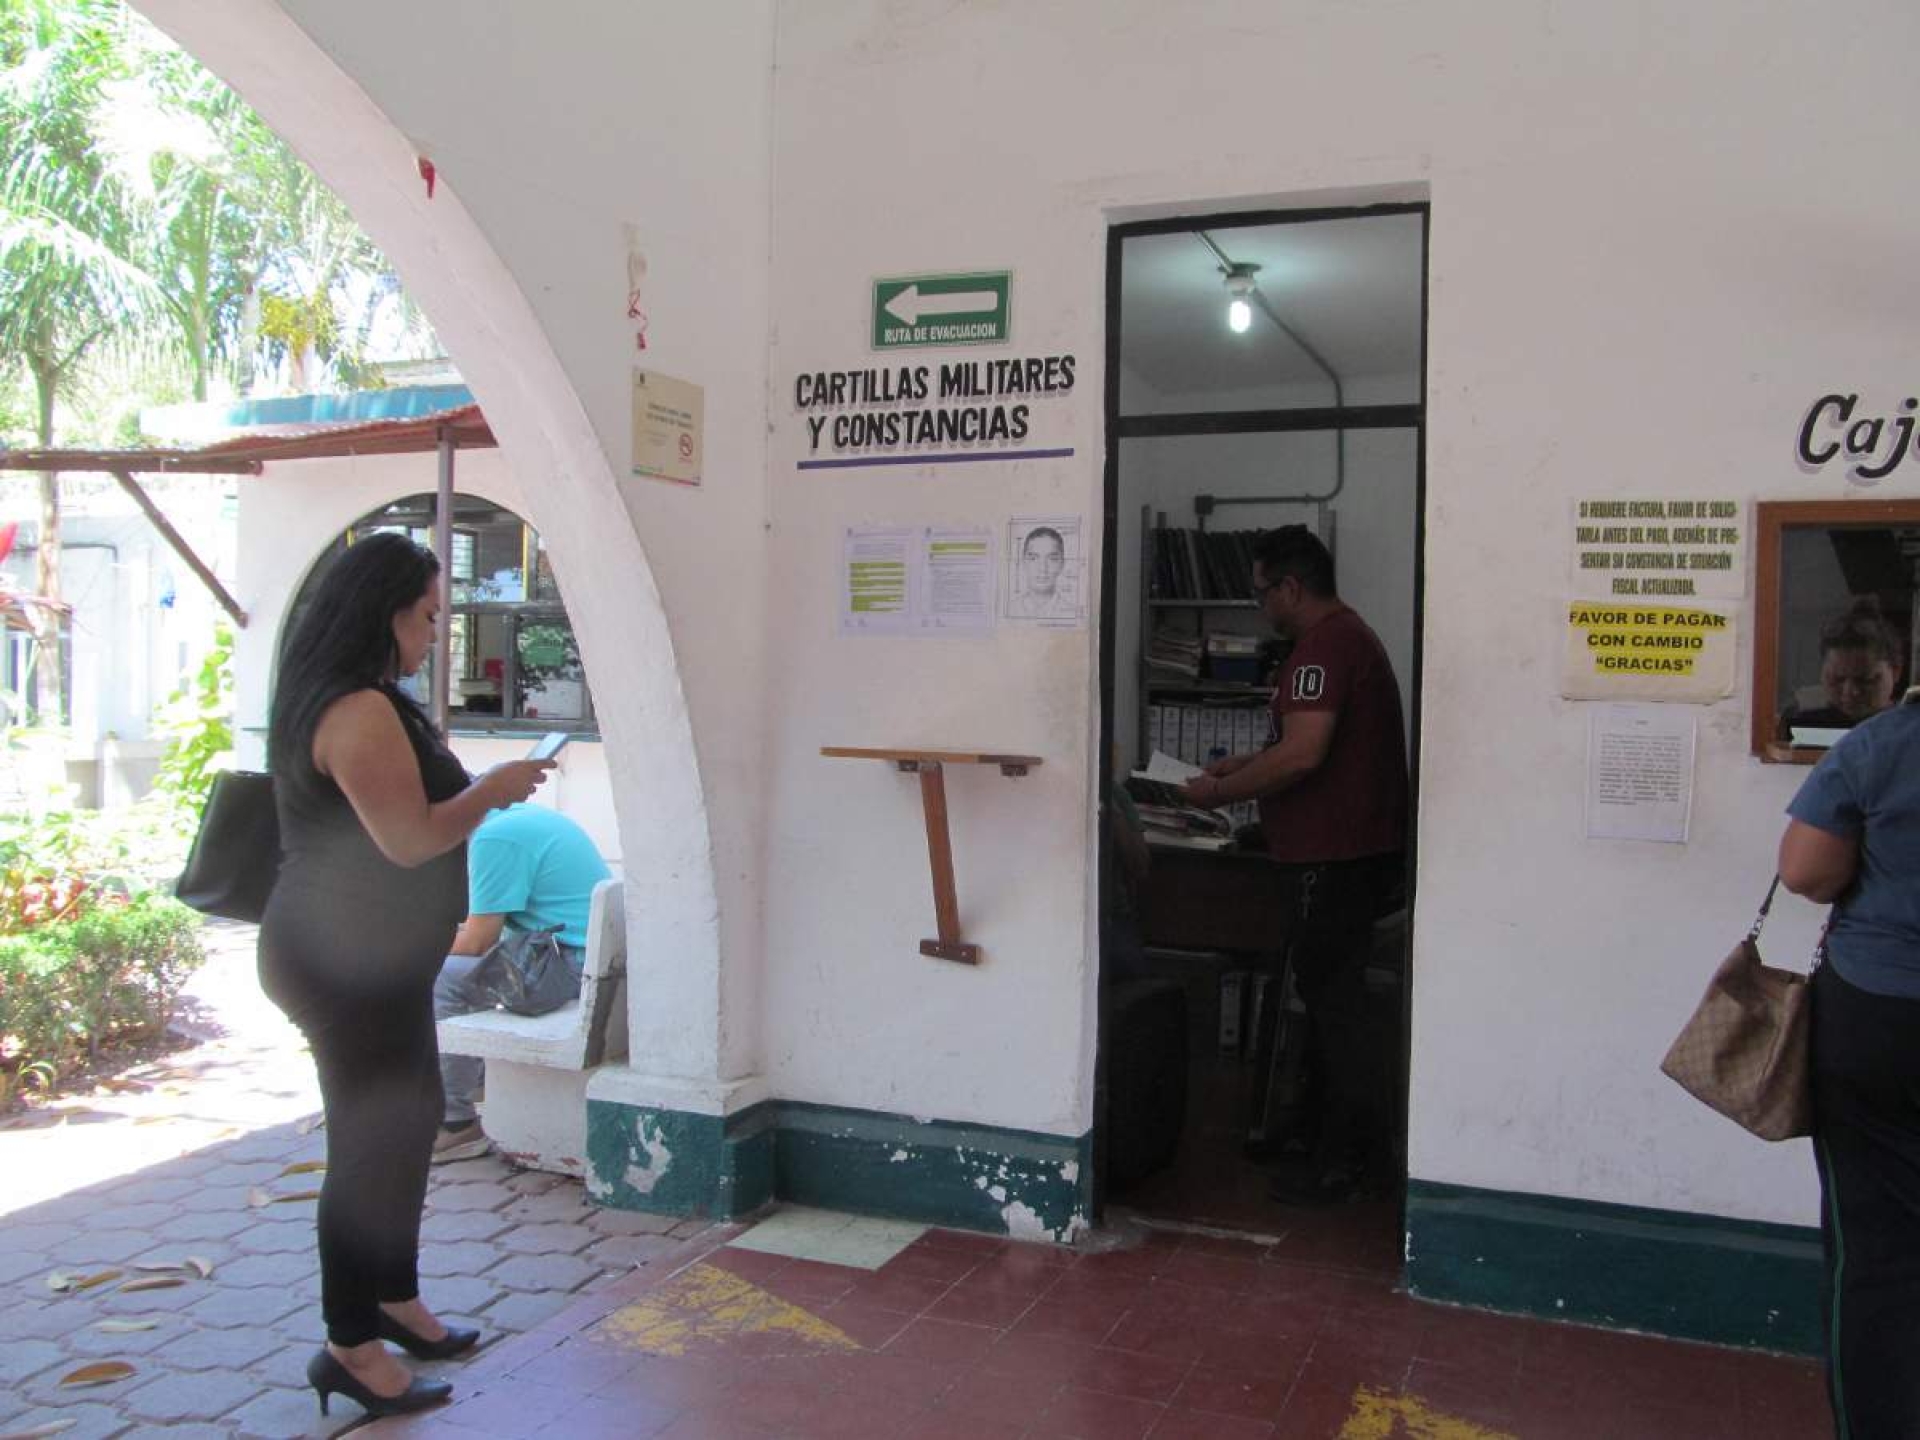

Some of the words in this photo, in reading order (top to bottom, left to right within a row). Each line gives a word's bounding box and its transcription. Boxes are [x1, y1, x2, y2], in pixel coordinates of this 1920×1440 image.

[884, 328, 911, 344] RUTA
[914, 327, 928, 341] DE
[796, 366, 929, 408] CARTILLAS
[939, 354, 1076, 398] MILITARES
[807, 415, 827, 450] Y
[833, 404, 1030, 449] CONSTANCIAS
[1799, 393, 1920, 479] Caj
[1580, 501, 1588, 518] SI
[1590, 501, 1627, 518] REQUIERE
[1668, 501, 1694, 518] FAVOR
[1696, 501, 1707, 518] DE
[1603, 527, 1628, 544] ANTES
[1630, 527, 1643, 544] DEL
[1707, 527, 1718, 544] DE
[1612, 552, 1624, 569] SU
[1626, 552, 1674, 569] CONSTANCIA
[1676, 552, 1688, 569] DE
[1612, 578, 1639, 595] FISCAL
[1569, 611, 1628, 625] FAVOR
[1634, 612, 1657, 625] DE
[1663, 613, 1727, 627] PAGAR
[1587, 634, 1625, 647] CON
[1631, 634, 1703, 649] CAMBIO
[1292, 665, 1325, 700] 10
